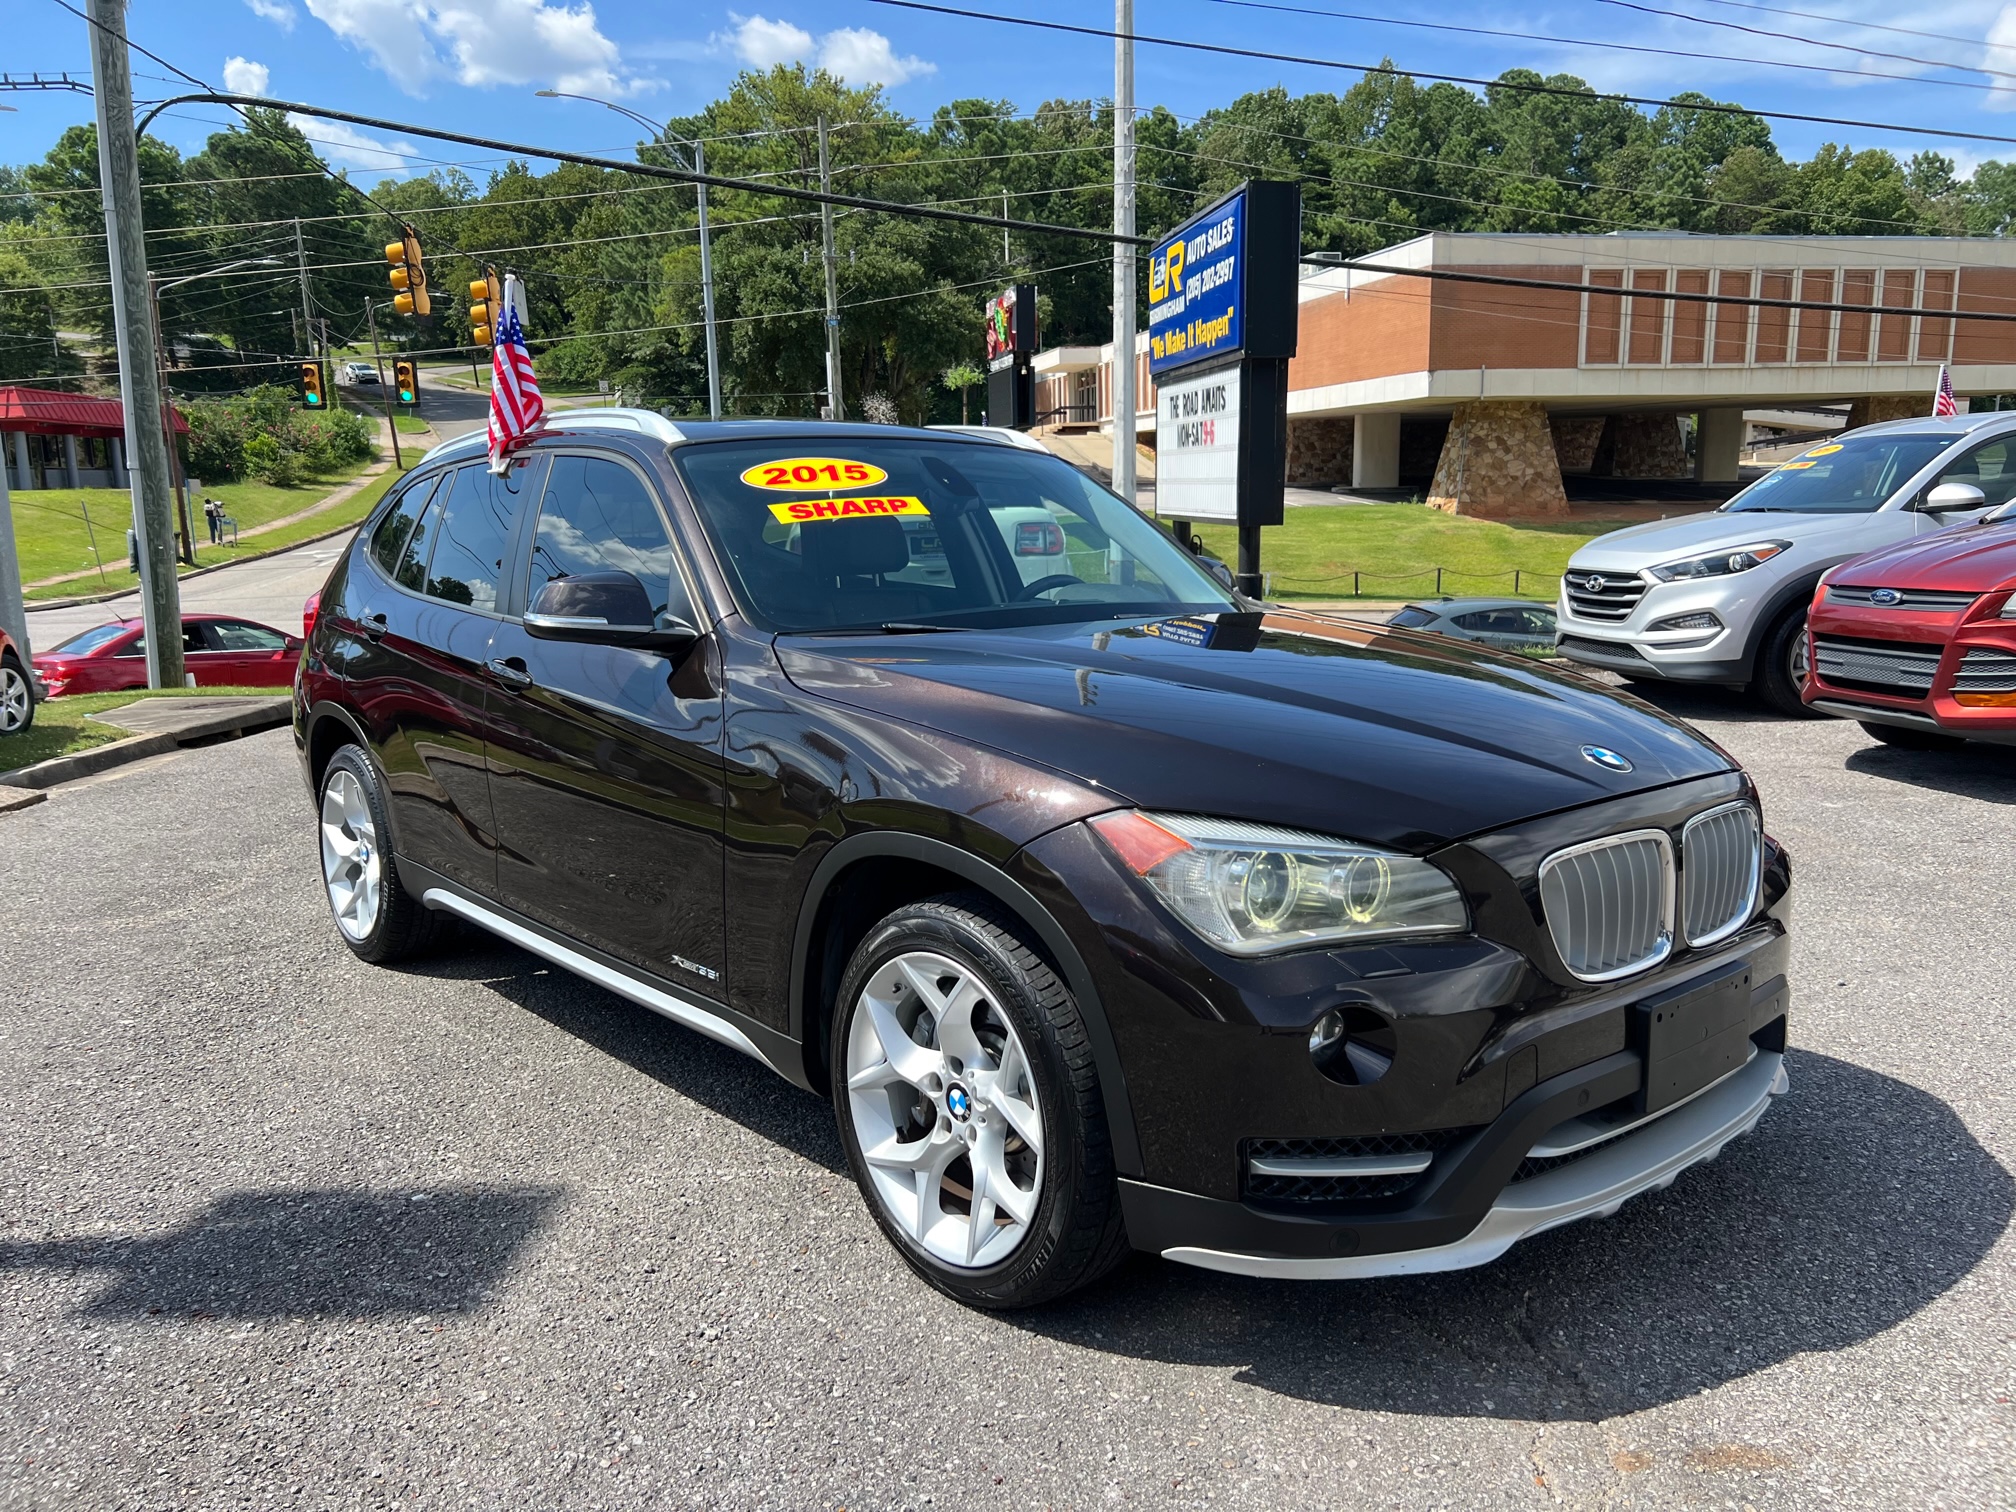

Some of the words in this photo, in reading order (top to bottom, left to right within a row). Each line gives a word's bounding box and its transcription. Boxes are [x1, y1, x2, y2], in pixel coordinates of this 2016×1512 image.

[1186, 233, 1207, 266] AUTO
[1207, 217, 1234, 254] SALES
[1186, 272, 1201, 306] (205)
[1202, 256, 1235, 292] 202-2997
[1151, 336, 1164, 360] "We
[1165, 328, 1186, 356] Make
[1188, 322, 1194, 348] It
[1195, 306, 1234, 348] Happen"
[1170, 394, 1179, 419] THE
[1183, 391, 1198, 417] ROAD
[1201, 385, 1226, 414] AWAITS
[762, 465, 870, 485] 2015
[788, 498, 911, 520] SHARP
